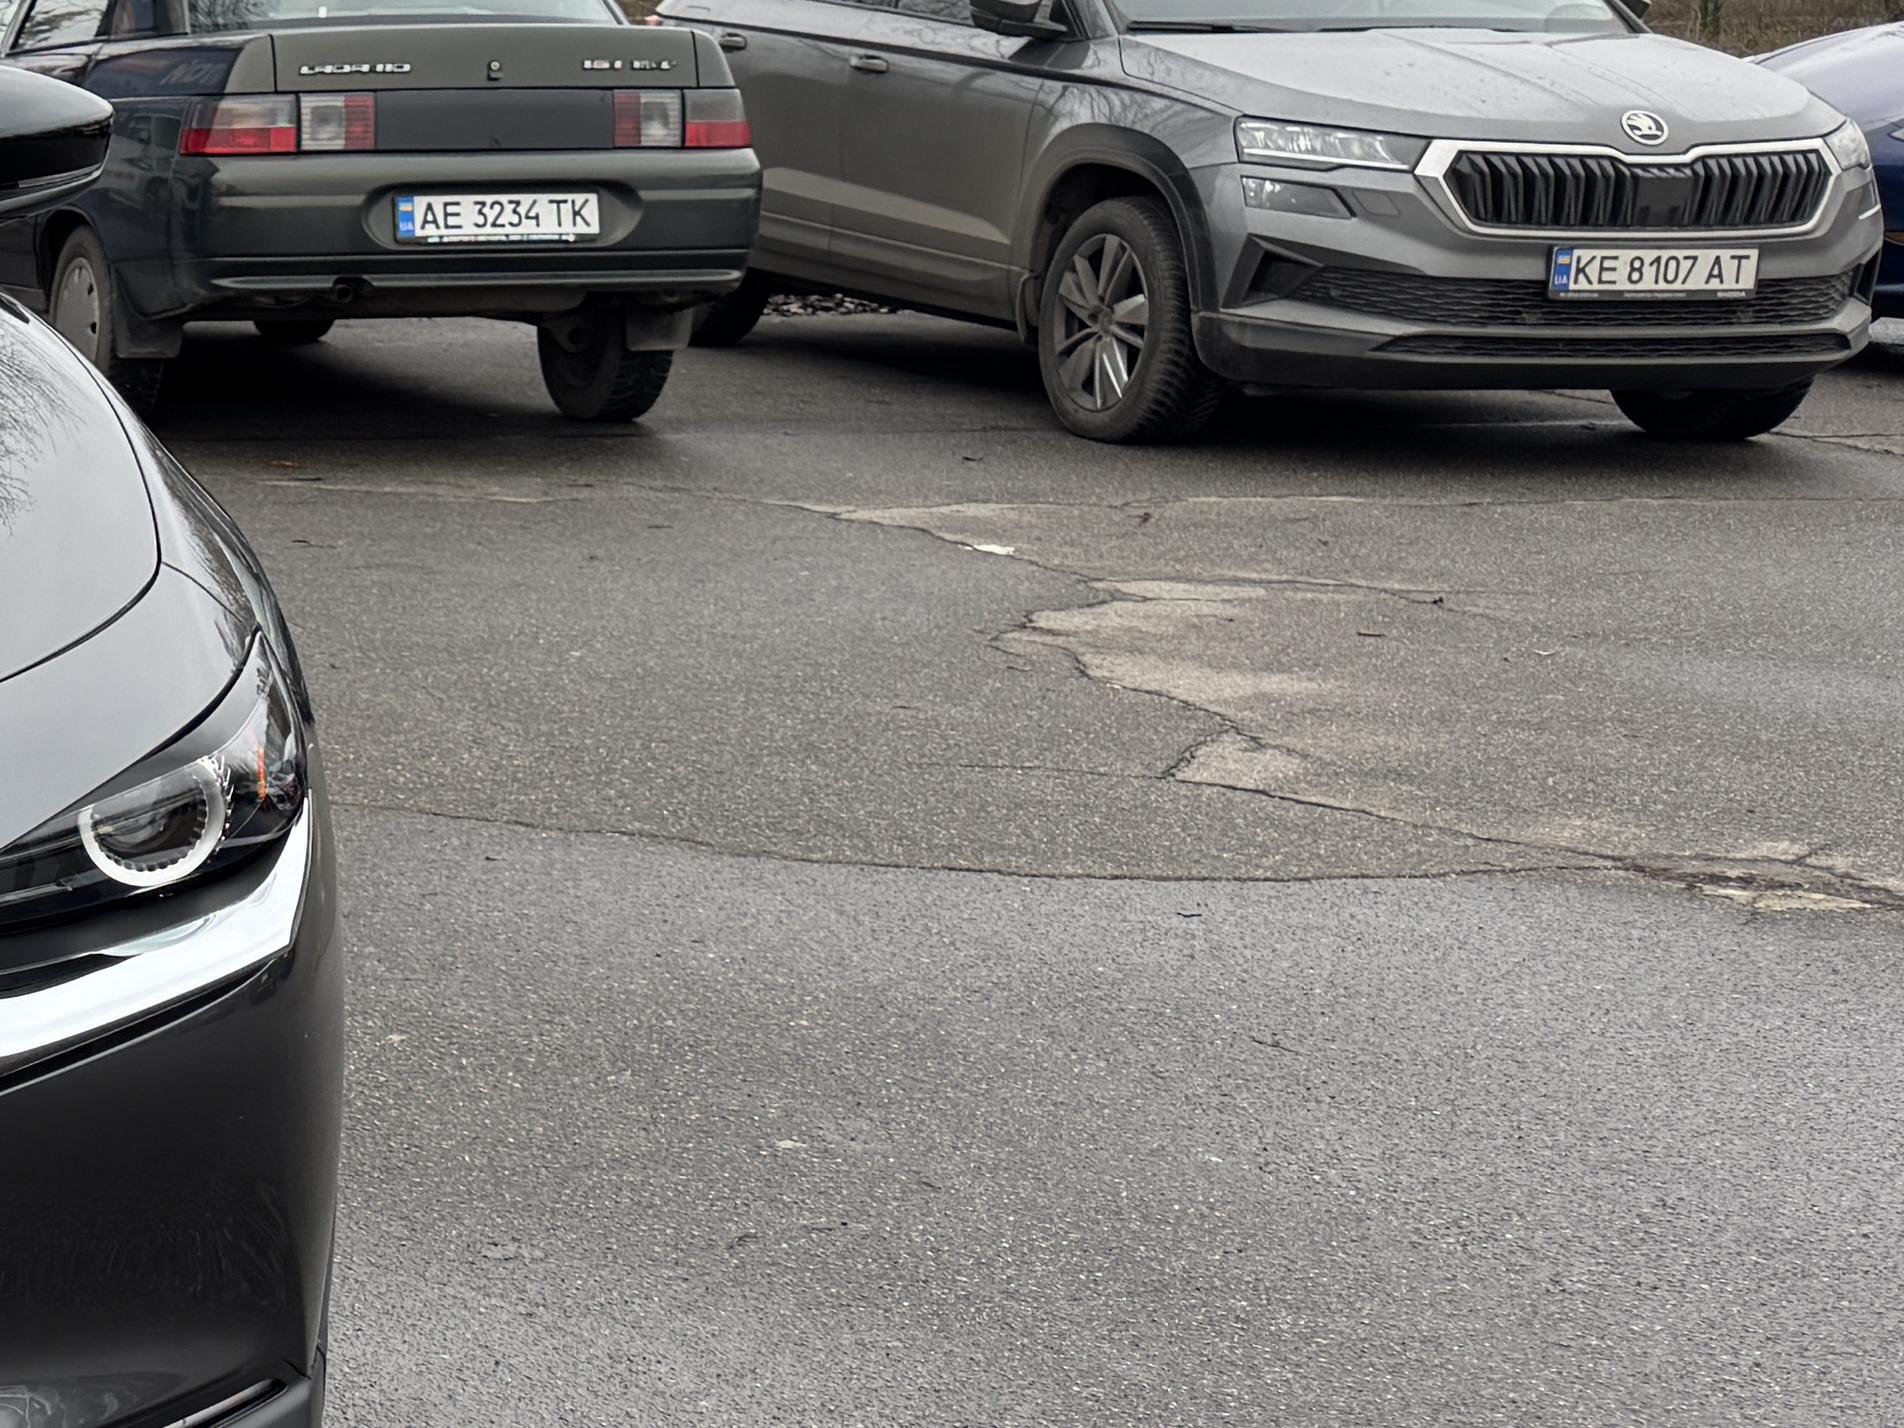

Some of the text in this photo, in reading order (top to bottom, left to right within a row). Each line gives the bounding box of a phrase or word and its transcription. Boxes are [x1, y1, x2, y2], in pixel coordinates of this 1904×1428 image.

[420, 198, 591, 230] AE 3234 TK
[1573, 254, 1751, 285] KE 8107 AT
